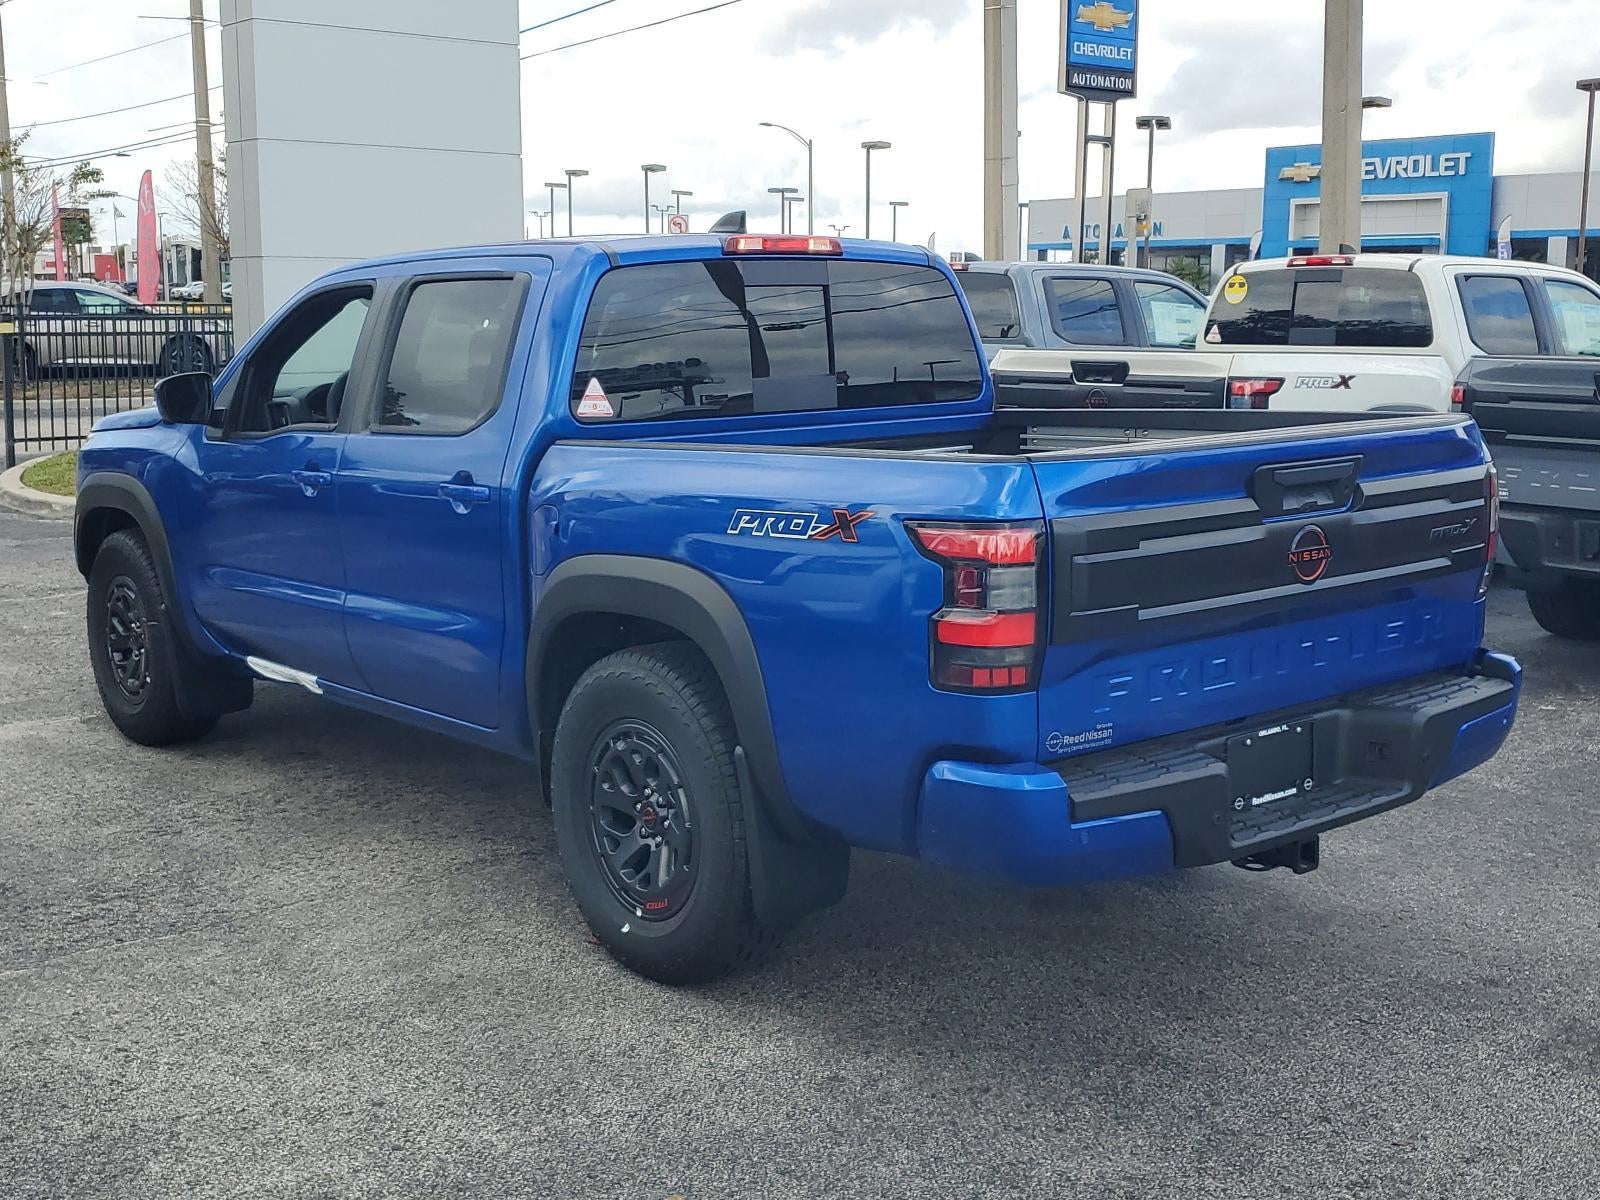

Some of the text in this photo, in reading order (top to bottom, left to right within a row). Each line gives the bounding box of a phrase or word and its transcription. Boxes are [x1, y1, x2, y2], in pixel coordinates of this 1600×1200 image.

[1073, 41, 1133, 61] CHEVROLET
[1072, 72, 1132, 90] AUTONATION
[1361, 152, 1471, 179] EVROLET
[1287, 546, 1332, 567] NISSAN
[1064, 729, 1112, 745] Reed Nissan
[1252, 788, 1296, 805] ReedNissan.com
